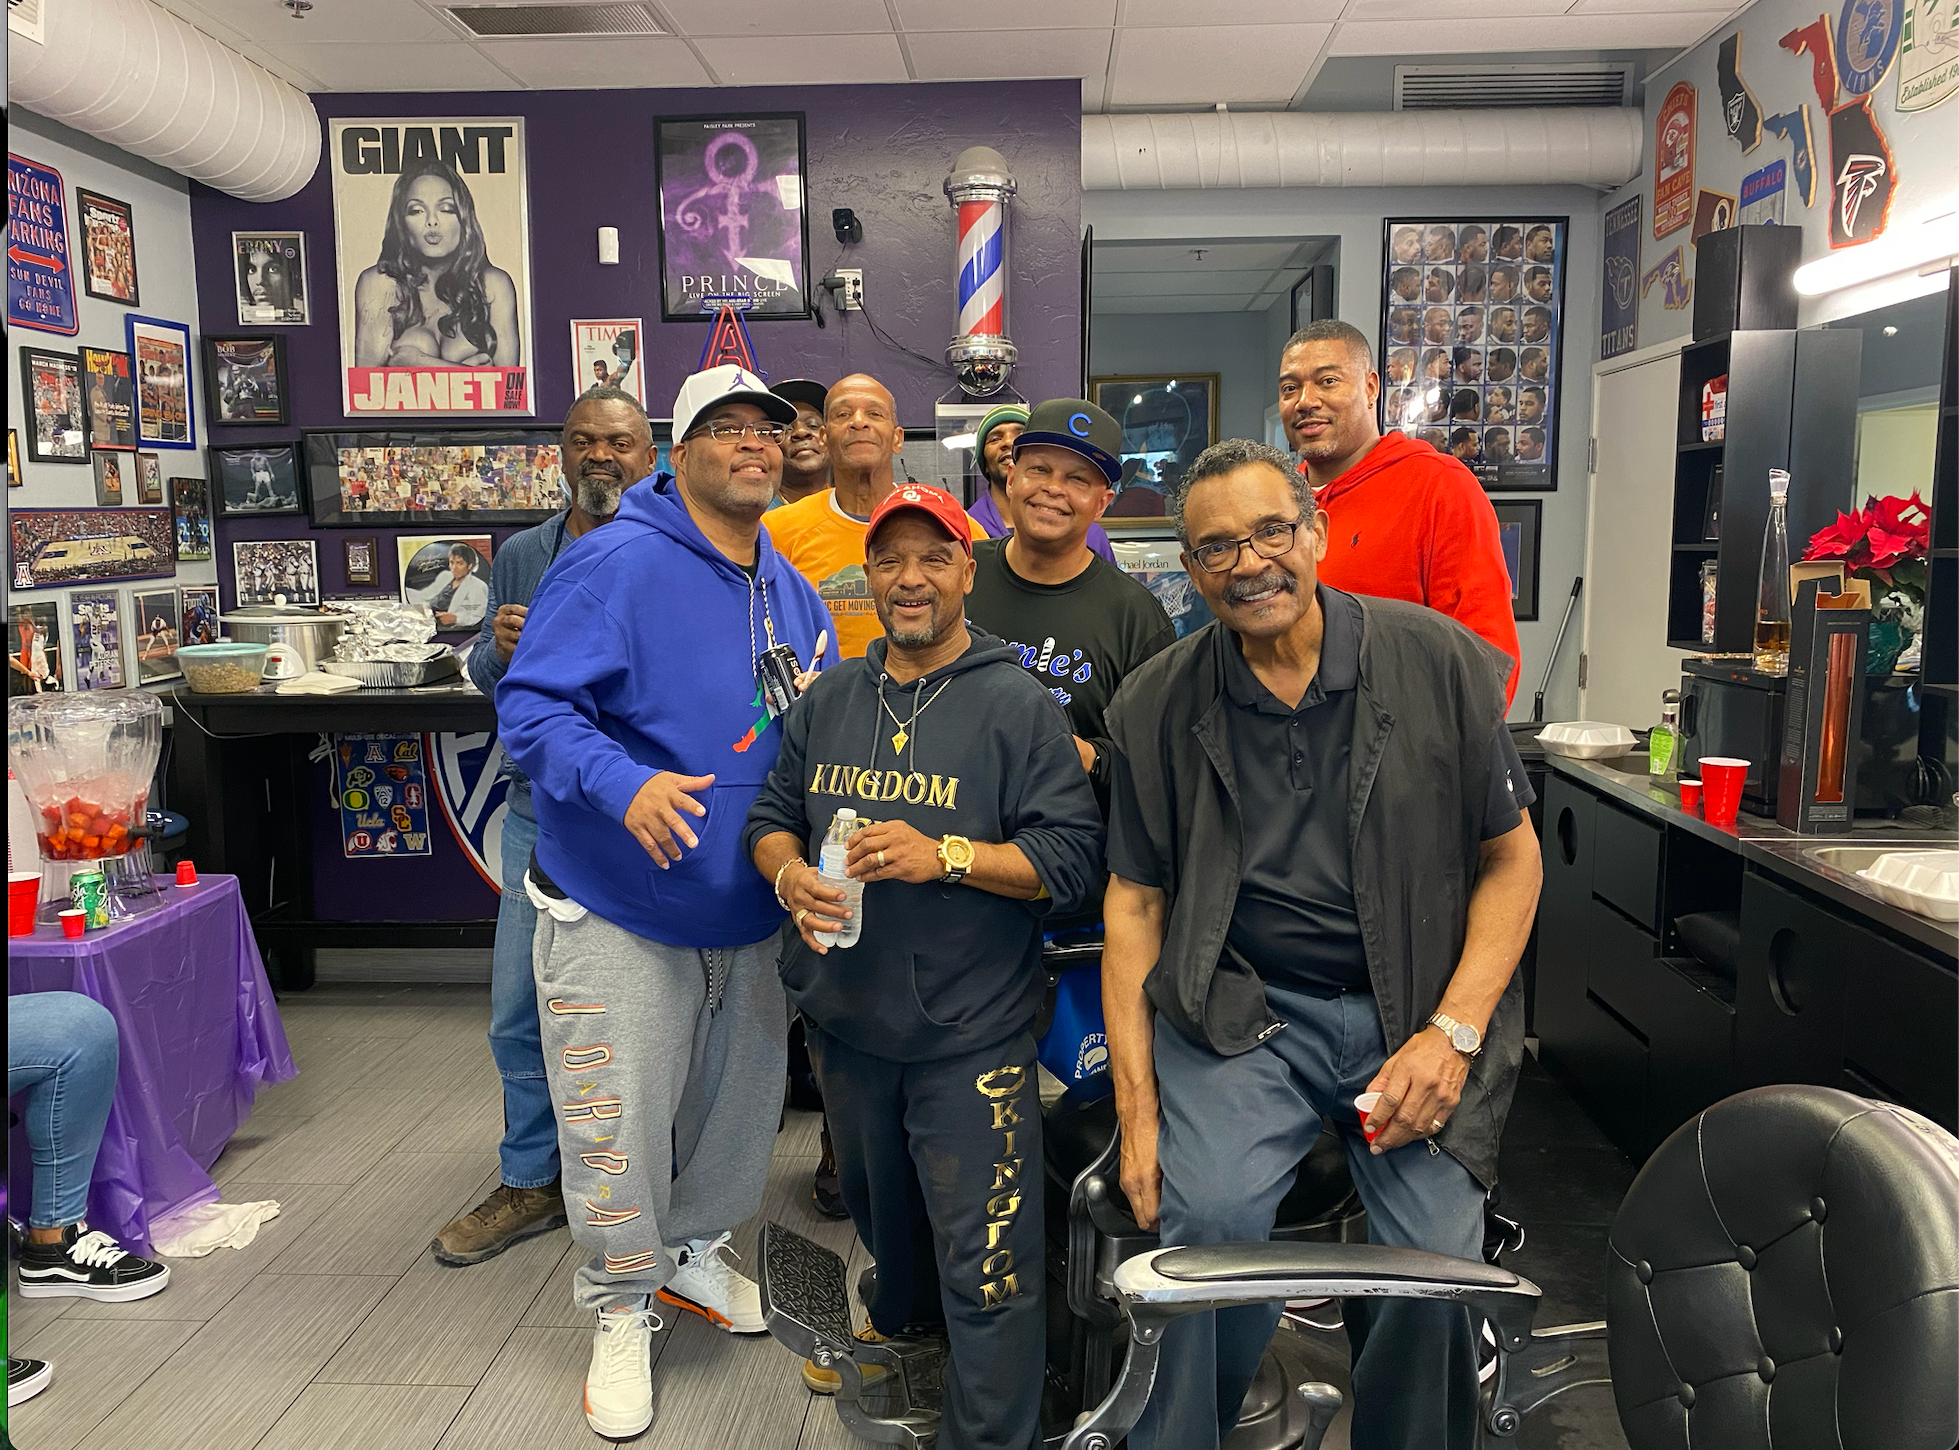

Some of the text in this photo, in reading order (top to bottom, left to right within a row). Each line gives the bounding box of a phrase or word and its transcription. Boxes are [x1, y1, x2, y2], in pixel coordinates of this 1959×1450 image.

[1845, 60, 1885, 92] LIONS
[1901, 68, 1948, 104] Established
[1663, 93, 1689, 121] CHIEFS
[341, 126, 513, 175] GIANT
[8, 168, 60, 207] RIZONA
[1743, 168, 1783, 199] BUFFALO
[8, 193, 53, 228] FANS
[1605, 198, 1639, 238] TENNESSEE
[8, 217, 65, 254] ARKING
[10, 266, 65, 292] SUN DEVIL
[681, 274, 789, 293] PRINCE
[26, 285, 52, 302] FANS
[753, 290, 781, 298] SCREEN
[1602, 324, 1635, 357] TITANS
[353, 372, 502, 410] JANET
[505, 372, 525, 390] ON
[504, 390, 523, 401] SALE
[1068, 412, 1092, 438] C
[883, 484, 944, 506] AHOMA
[1142, 559, 1169, 570] Jordan
[833, 600, 846, 611] GET
[848, 600, 876, 611] MOVING
[364, 743, 387, 763] A
[393, 741, 418, 762] Cal
[808, 763, 961, 810] KINGDOM
[403, 833, 426, 850] W
[546, 997, 657, 1275] JORDAN
[575, 1080, 615, 1200] AIR
